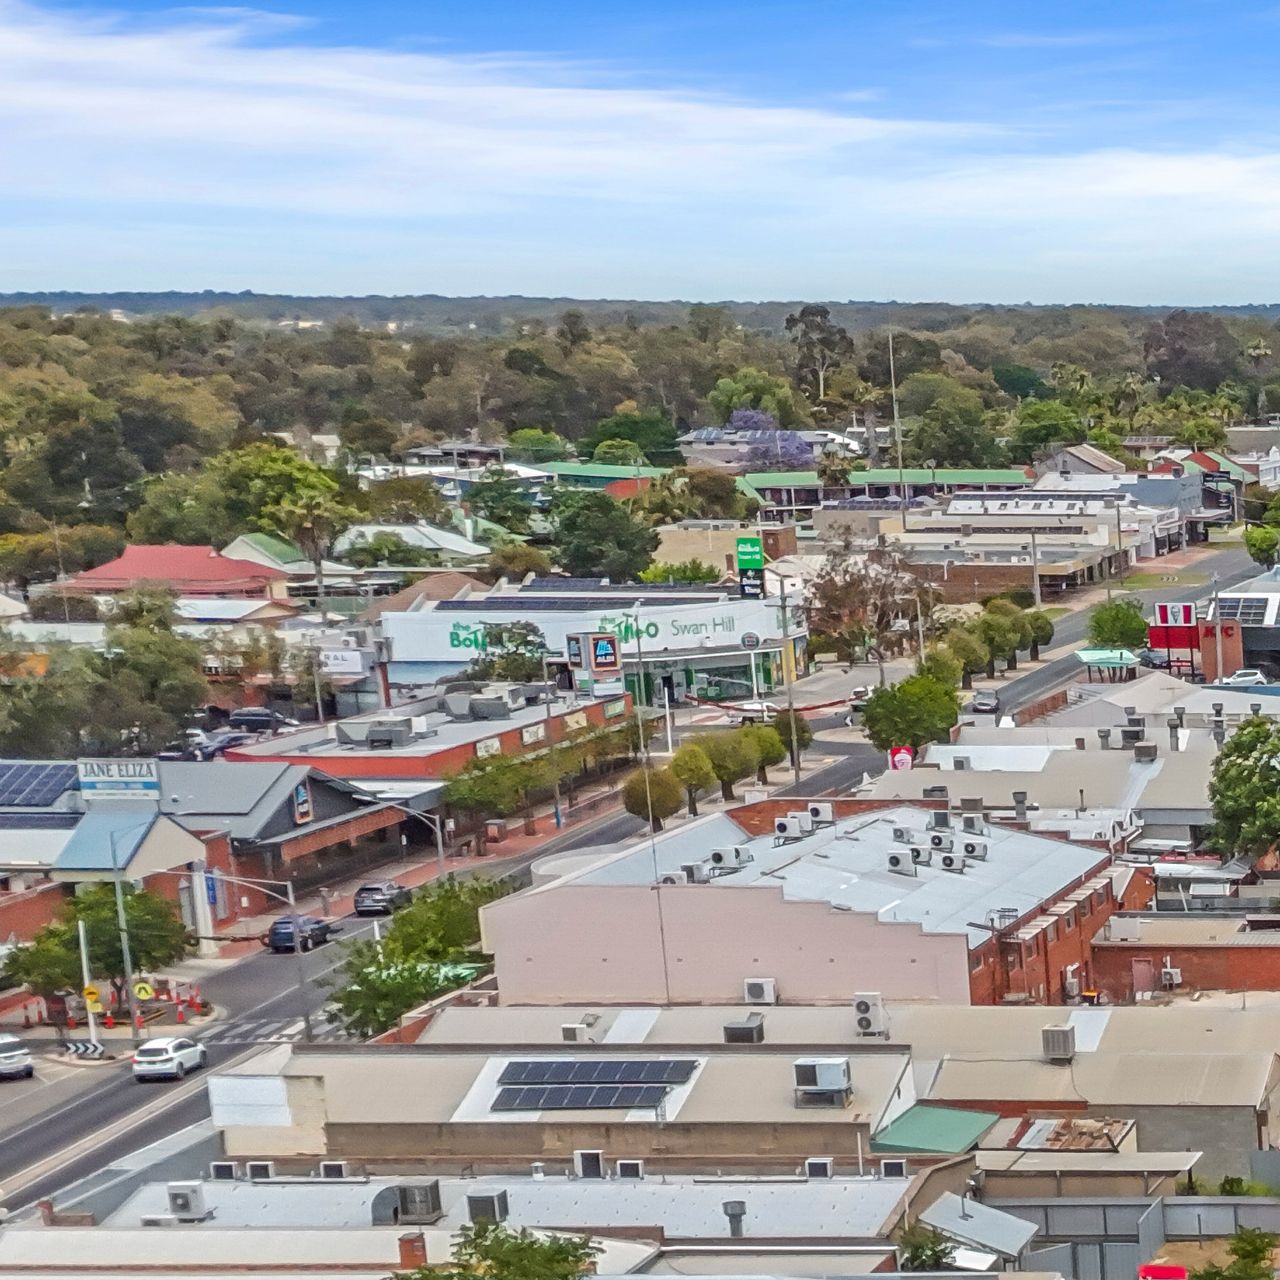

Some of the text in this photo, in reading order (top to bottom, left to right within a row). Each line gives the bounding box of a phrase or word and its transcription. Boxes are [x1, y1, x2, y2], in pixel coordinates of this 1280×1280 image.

[452, 621, 471, 633] the
[671, 615, 735, 637] Swan Hill
[1203, 626, 1235, 638] KC
[83, 762, 154, 778] JANE ELIZA
